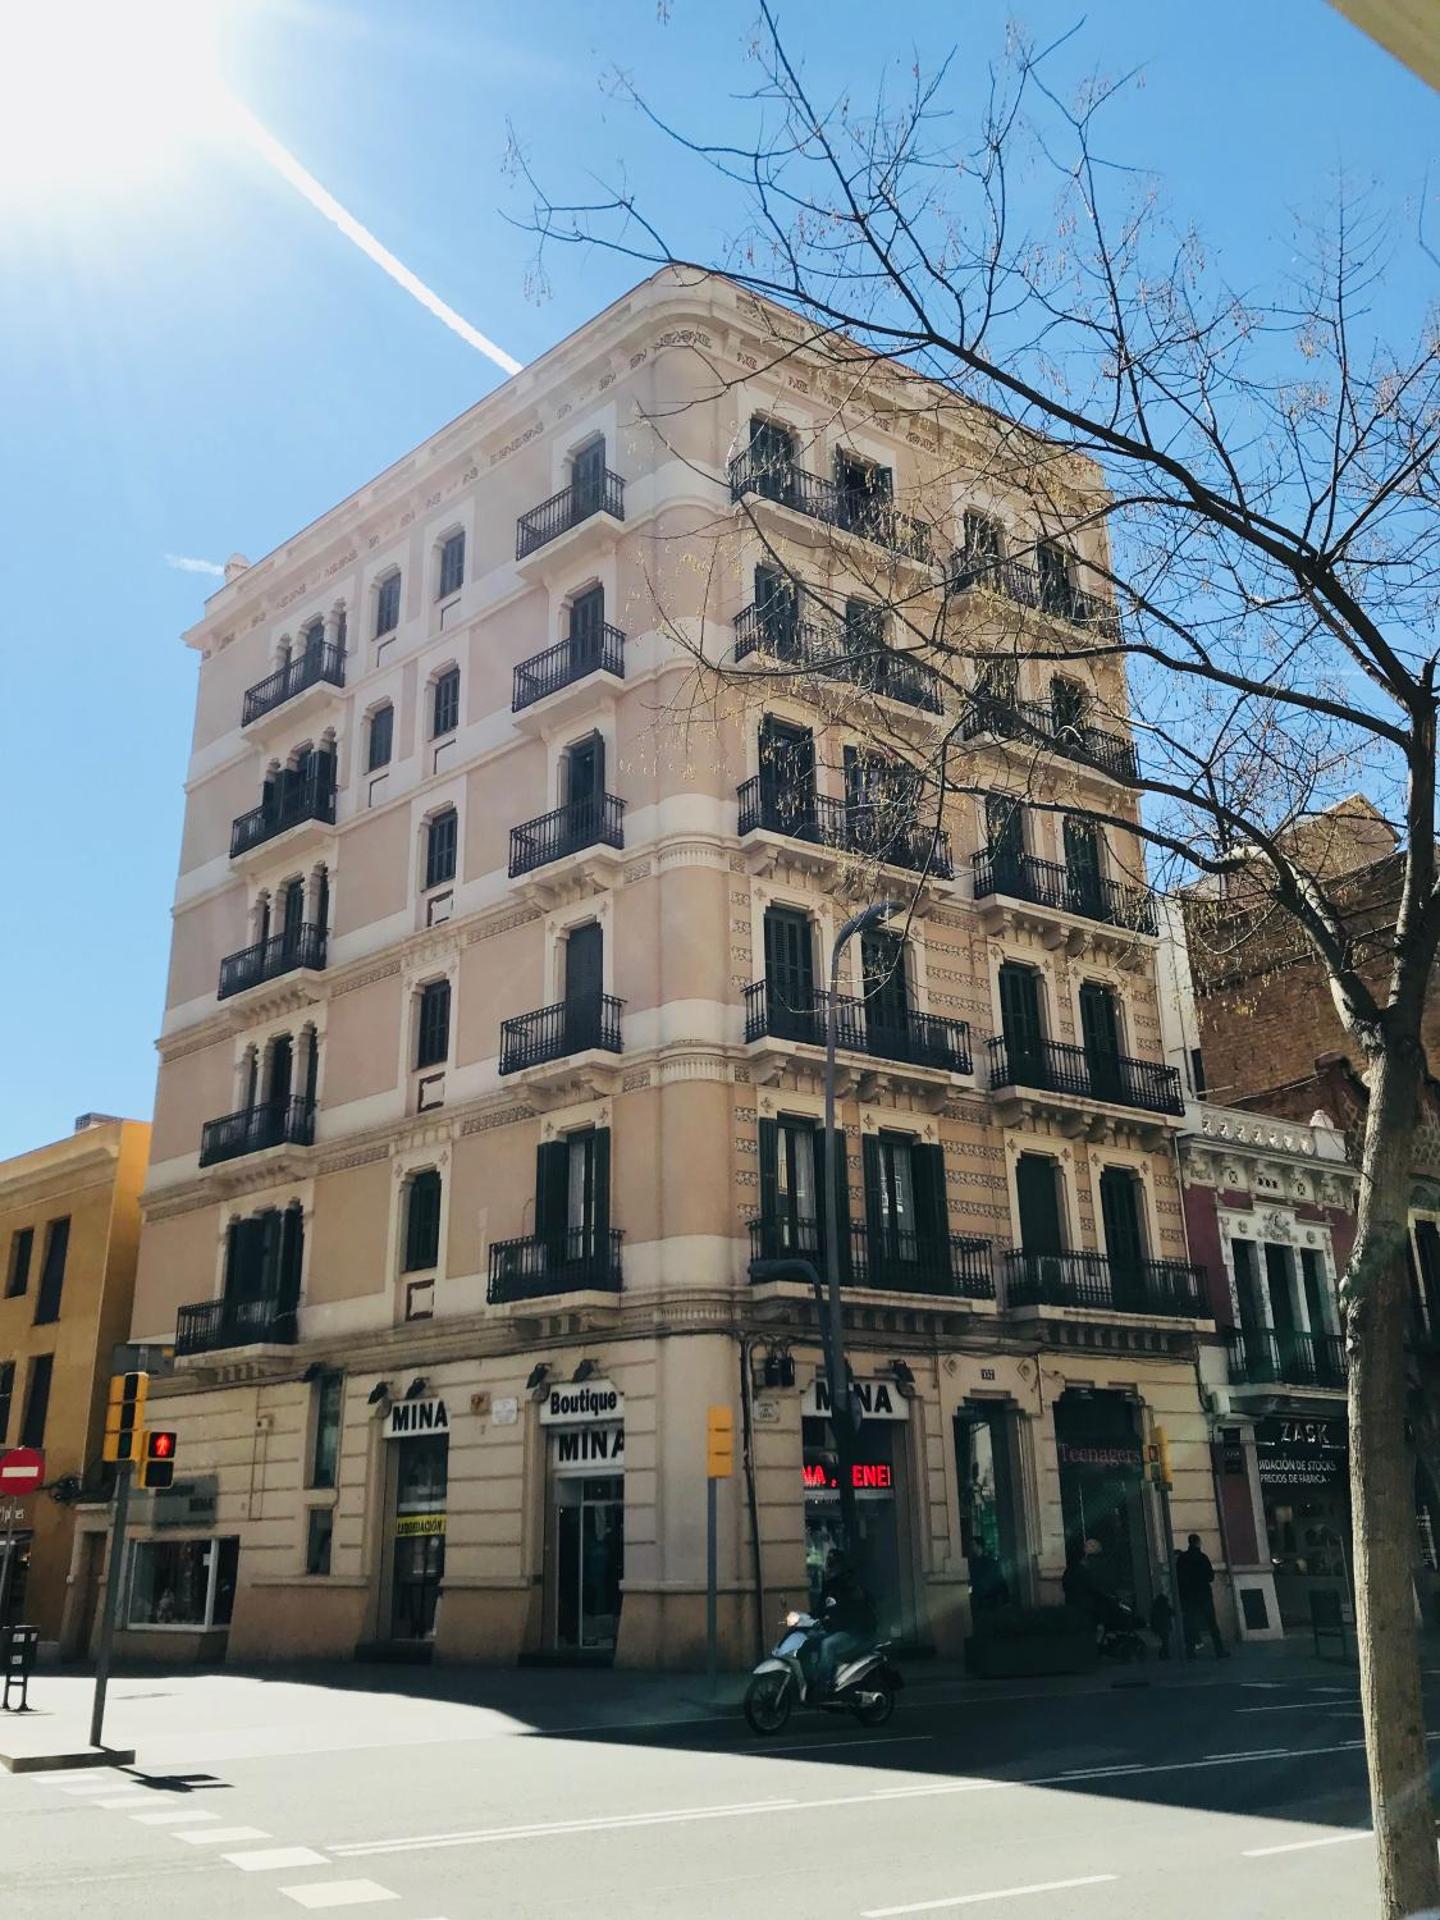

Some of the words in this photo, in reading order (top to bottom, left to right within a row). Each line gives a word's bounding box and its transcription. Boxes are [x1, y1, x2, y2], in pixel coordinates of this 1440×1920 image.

[550, 1388, 618, 1417] Boutique
[816, 1381, 893, 1413] MNA
[391, 1400, 449, 1432] MINA
[852, 1464, 891, 1487] ENE
[1296, 1460, 1306, 1471] DE
[1288, 1474, 1299, 1484] DE
